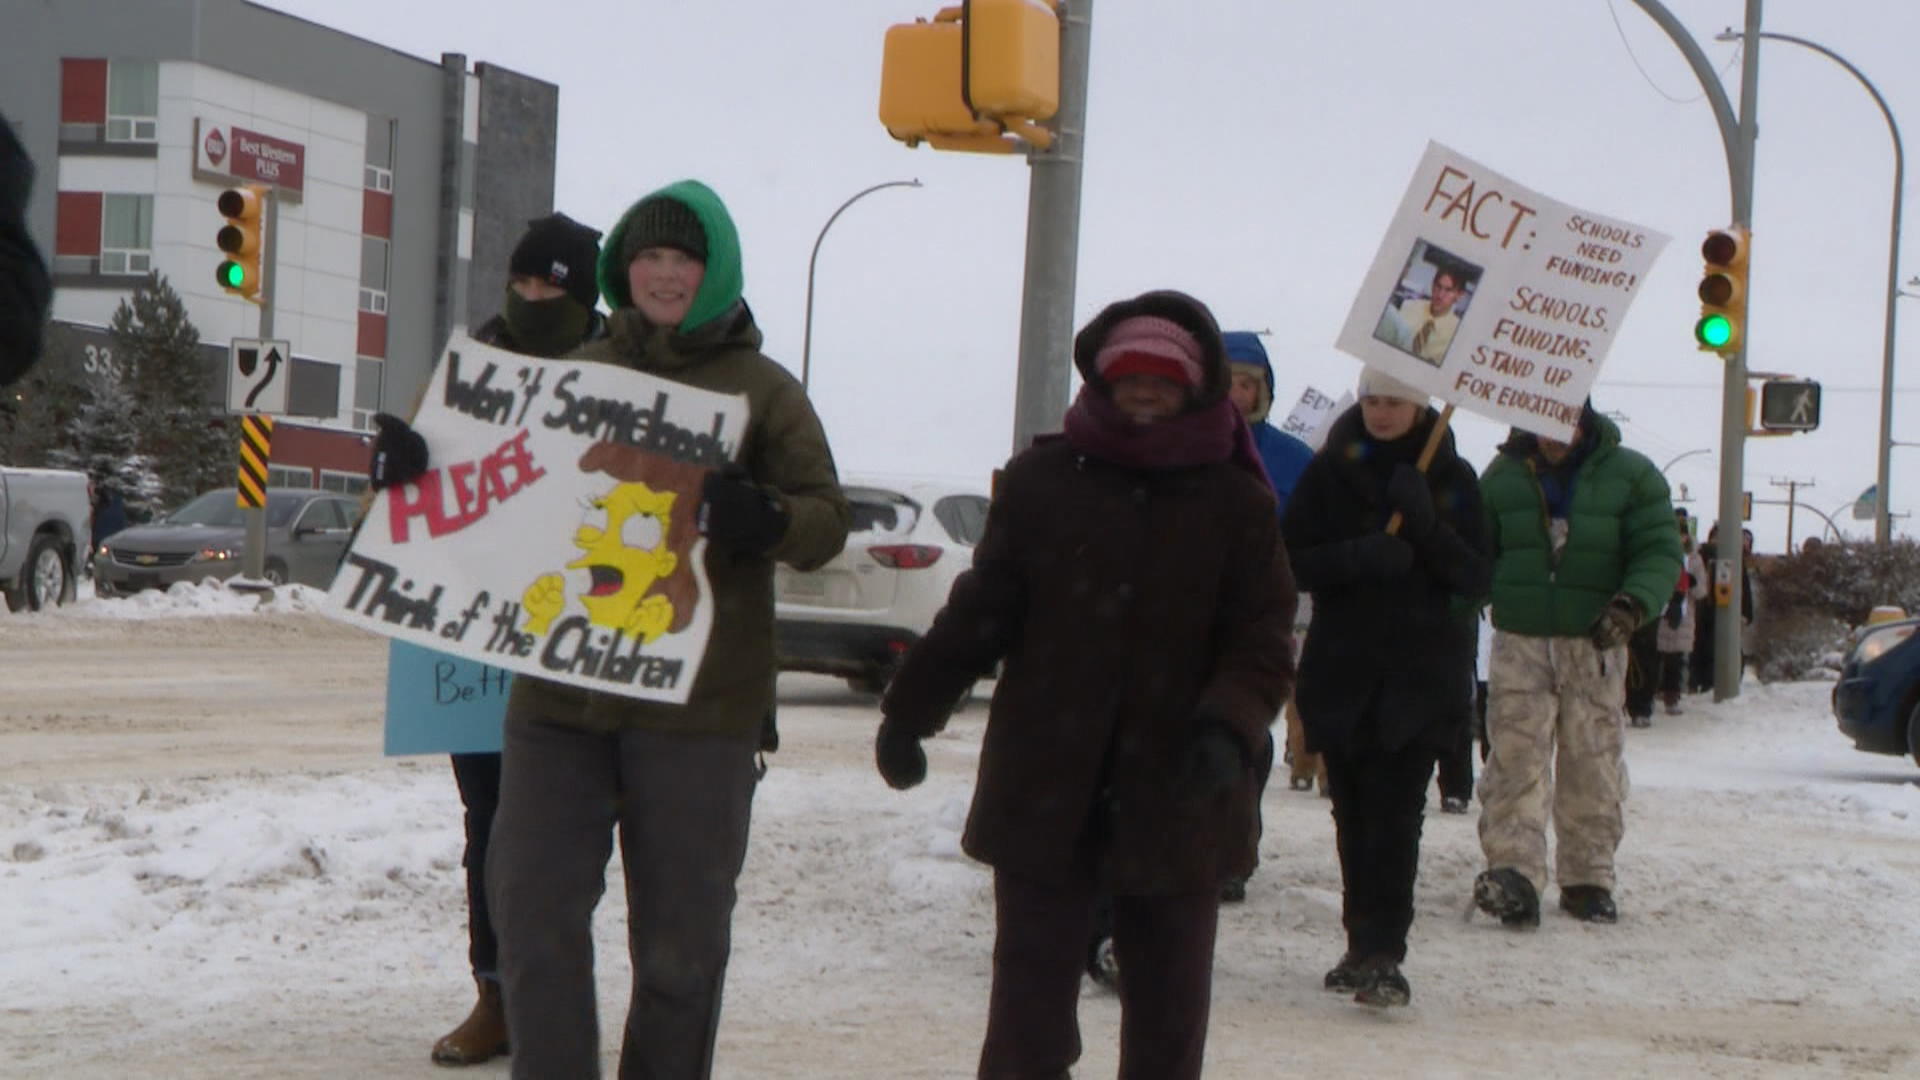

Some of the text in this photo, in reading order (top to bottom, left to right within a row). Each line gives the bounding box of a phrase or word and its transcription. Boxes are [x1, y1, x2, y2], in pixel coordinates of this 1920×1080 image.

[240, 136, 296, 166] Best Western
[256, 158, 280, 177] PLUS
[1424, 165, 1537, 250] FACT:
[1566, 215, 1646, 249] SCHOOLS
[1577, 242, 1622, 264] NEED
[1546, 256, 1637, 292] FUNDING!
[1509, 287, 1609, 332] SCHOOLS.
[1493, 318, 1594, 364] FUNDING.
[1454, 372, 1497, 400] FOR
[1470, 345, 1573, 387] STAND UP
[445, 351, 544, 426] Won't
[387, 429, 547, 544] PLEASE
[345, 552, 685, 690] Think of the Children
